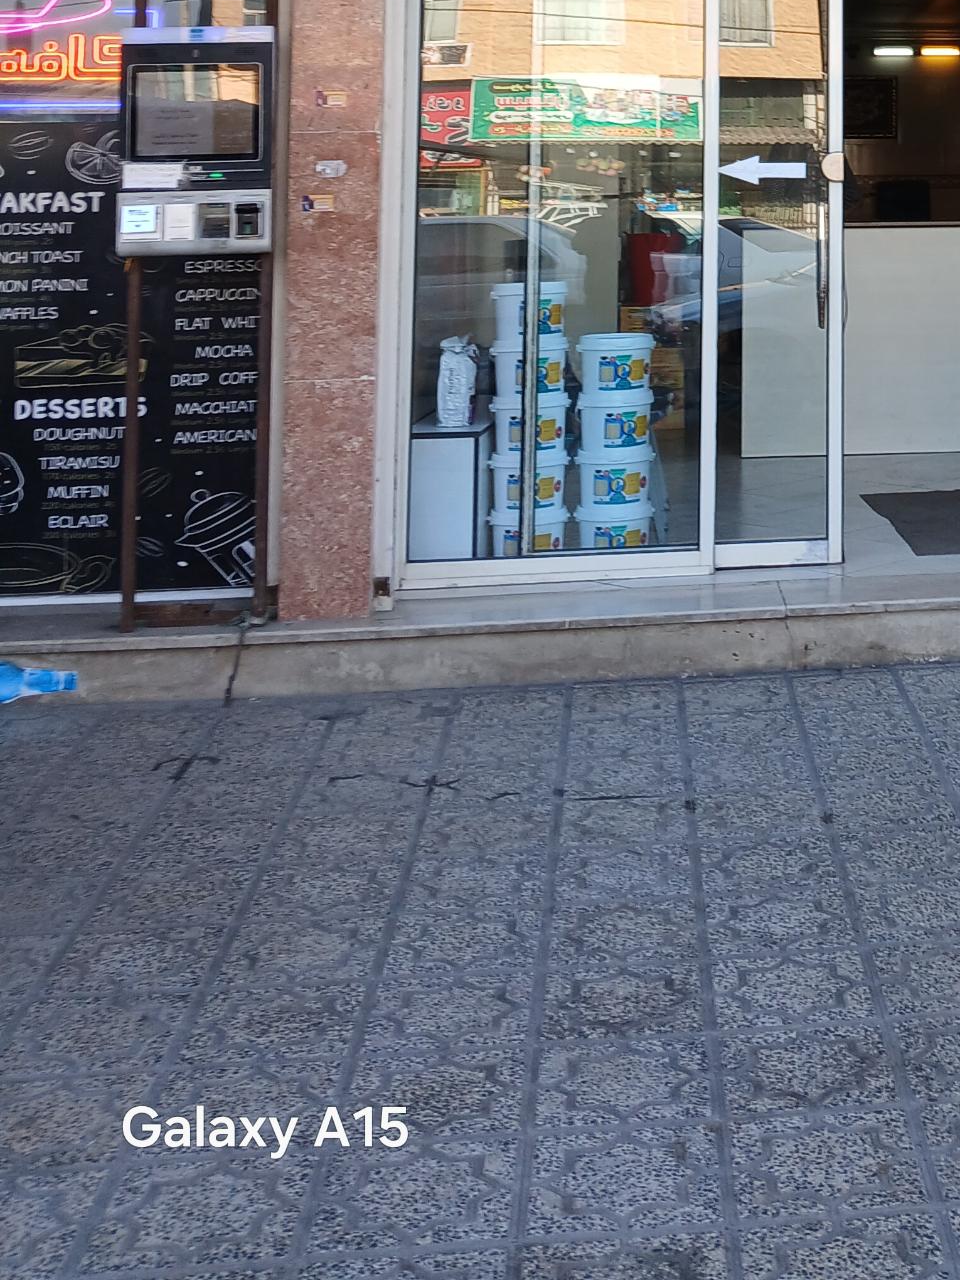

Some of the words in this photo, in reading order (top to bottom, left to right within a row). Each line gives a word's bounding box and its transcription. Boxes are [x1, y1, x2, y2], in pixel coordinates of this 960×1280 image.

[0, 191, 106, 214] AKFAST
[0, 222, 75, 235] OISSANT
[0, 251, 28, 264] NCH
[30, 250, 84, 264] TOAST
[174, 317, 214, 331] FLAT
[195, 344, 254, 359] MOCHA
[170, 372, 209, 387] DRIP
[218, 371, 260, 385] COFF
[174, 400, 259, 415] MACCHIAT
[33, 426, 127, 441] DOUGHNUT
[173, 428, 258, 444] AMERICAN
[38, 455, 121, 470] TIRAMISU
[47, 484, 110, 499] MUFFIN
[48, 514, 109, 529] ECLAIR
